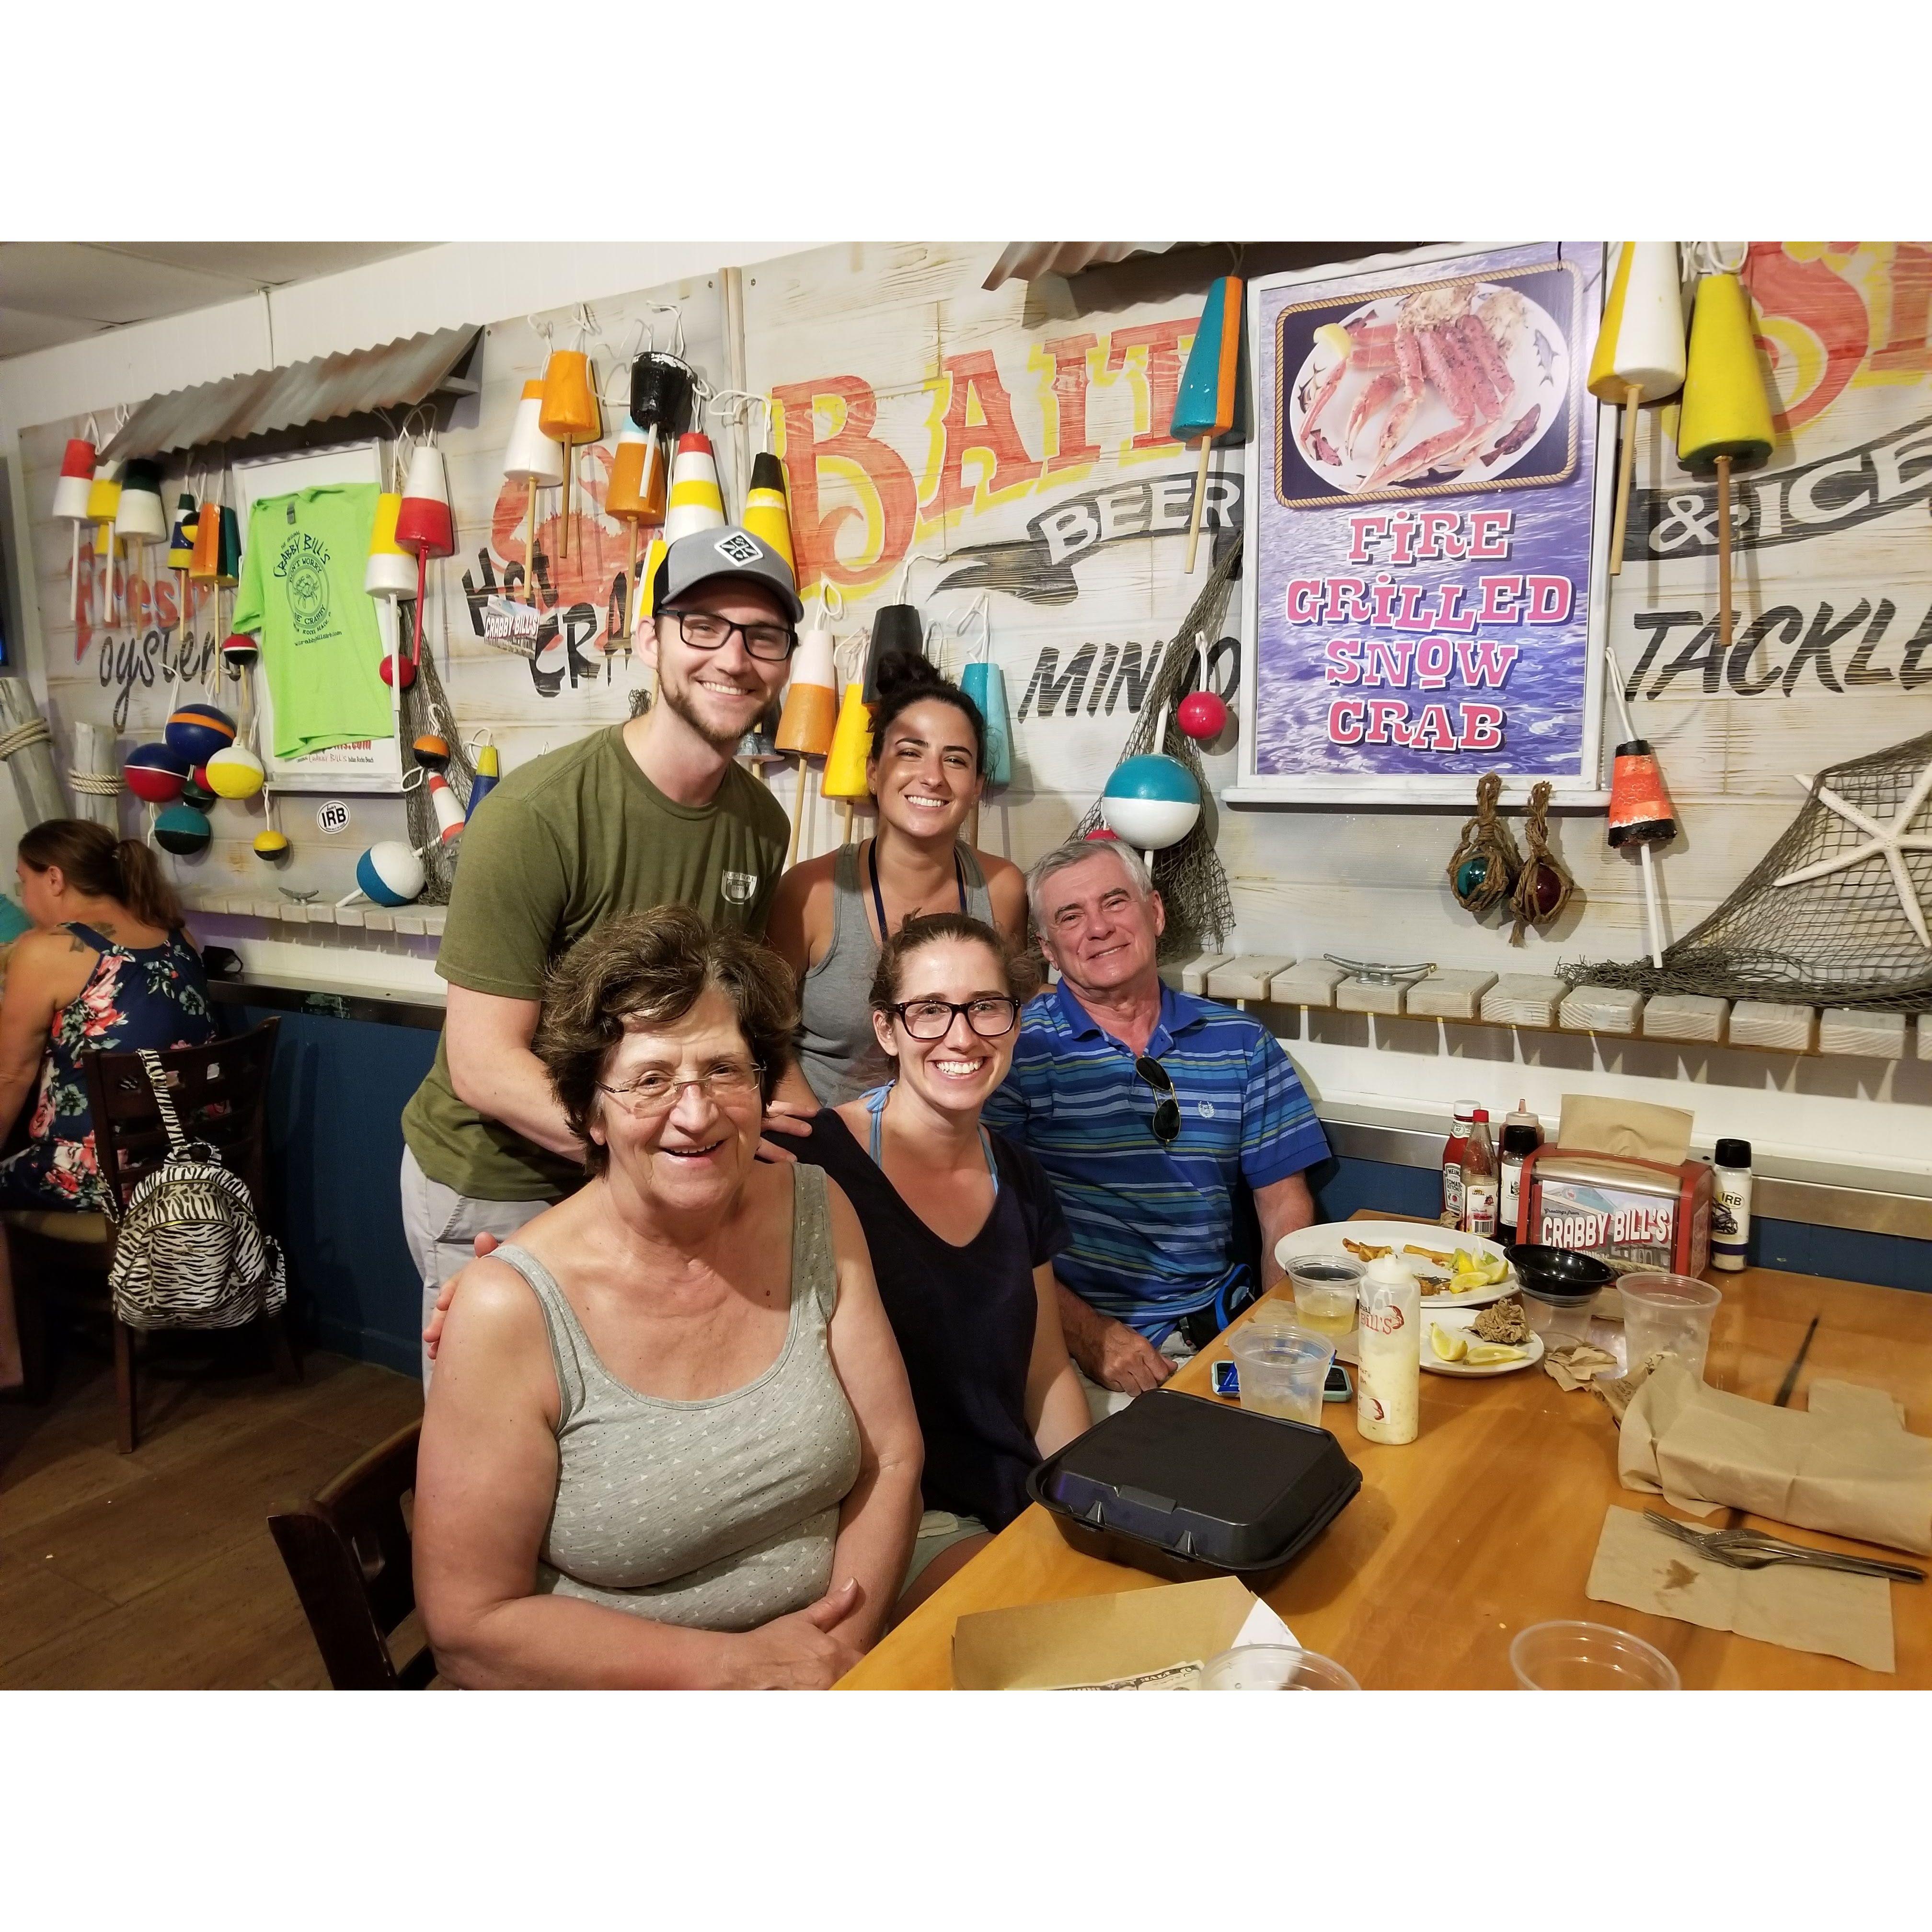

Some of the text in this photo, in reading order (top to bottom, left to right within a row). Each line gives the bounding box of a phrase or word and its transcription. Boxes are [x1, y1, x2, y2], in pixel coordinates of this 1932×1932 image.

[770, 317, 1202, 592] BAIT
[1039, 478, 1241, 565] BEER
[302, 558, 322, 574] WORRY
[304, 604, 325, 625] CRABBY
[485, 615, 515, 638] CRABBY
[1325, 635, 1521, 690] SNOW
[1328, 699, 1506, 751] CRAB
[322, 807, 346, 828] IRB
[1722, 1193, 1741, 1206] IRB
[1542, 1208, 1668, 1248] CRABBY BILL'S
